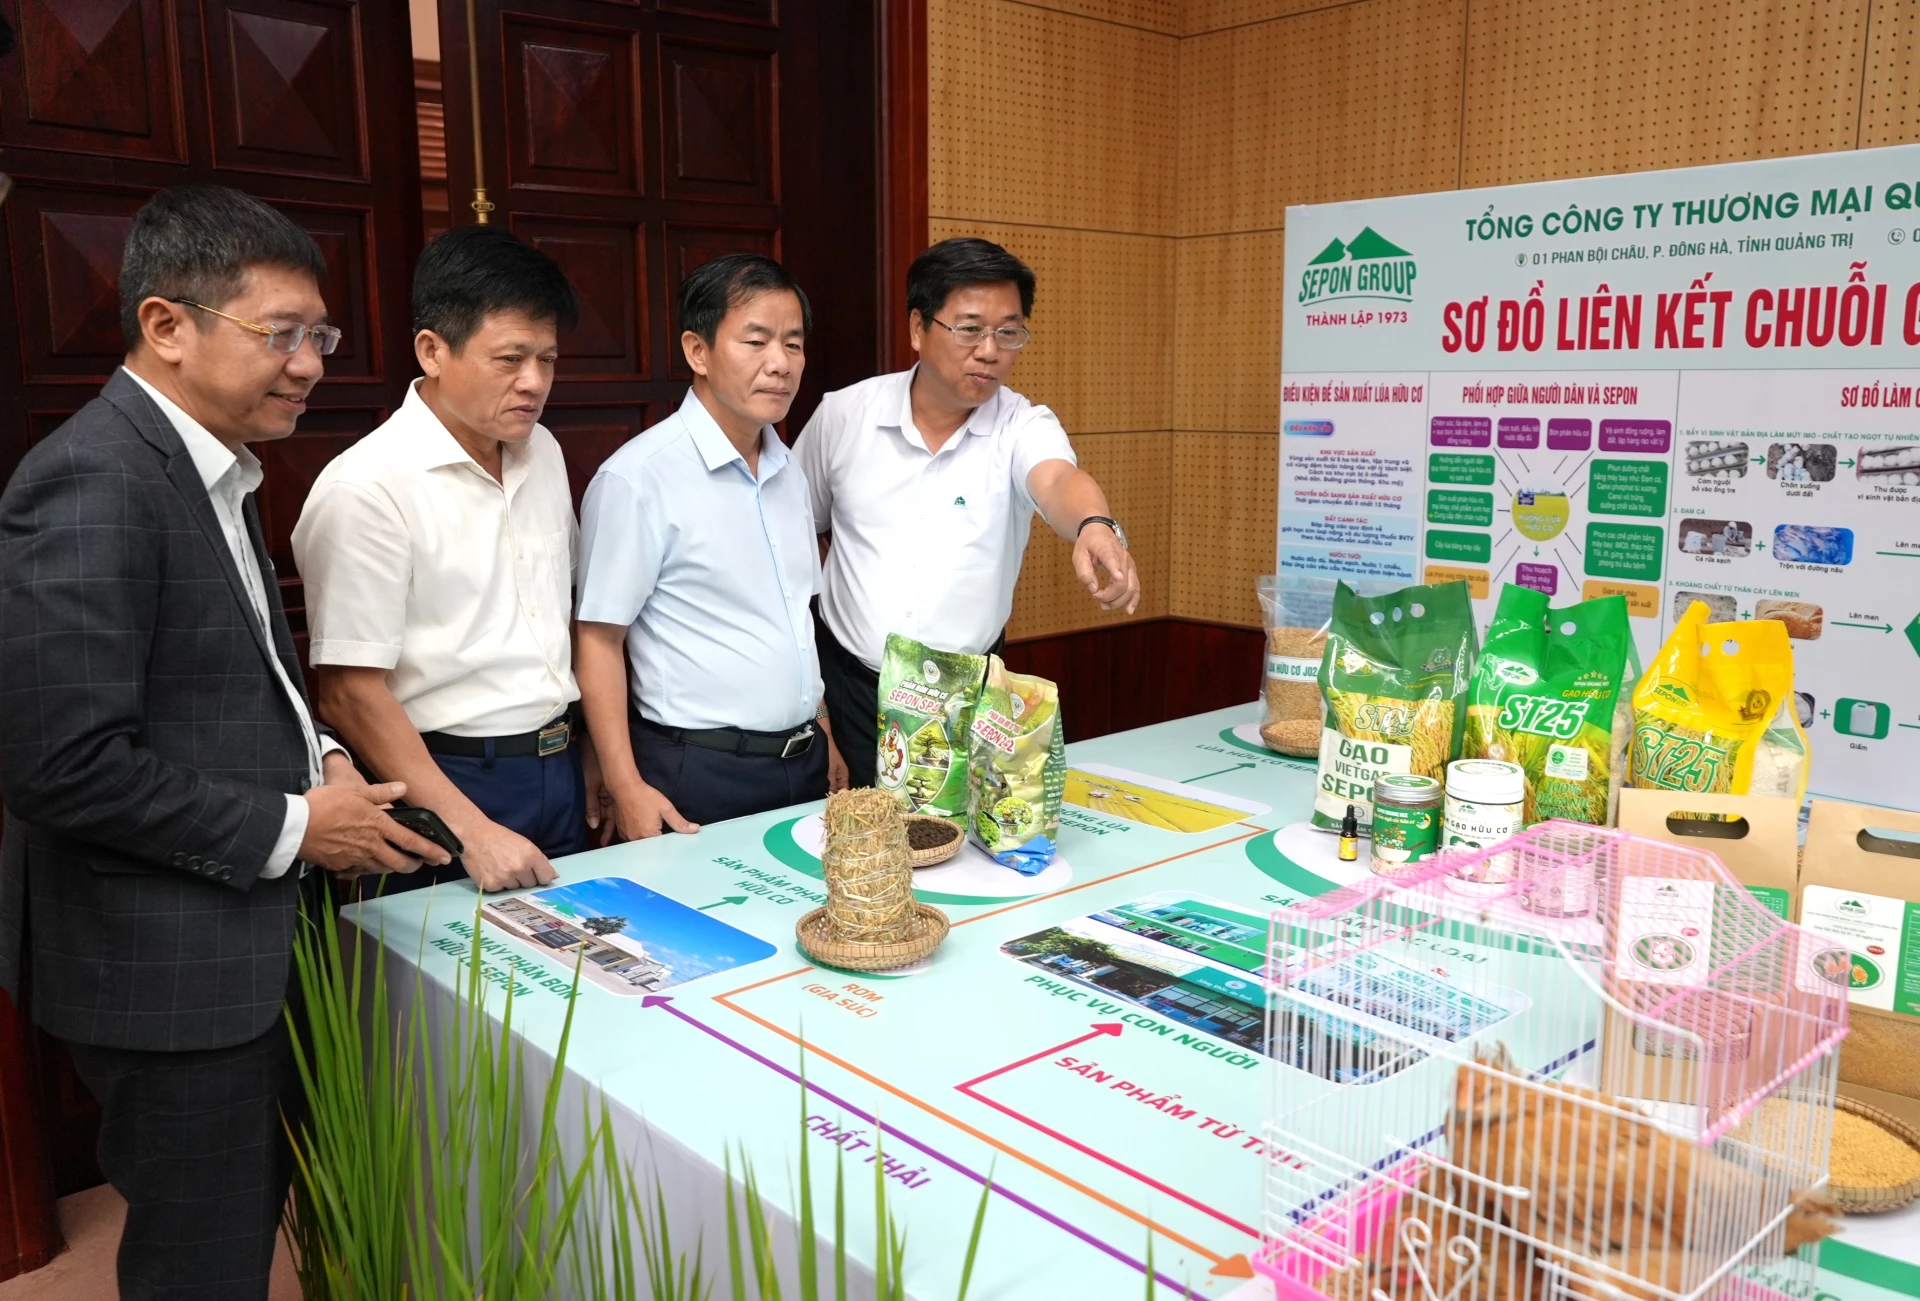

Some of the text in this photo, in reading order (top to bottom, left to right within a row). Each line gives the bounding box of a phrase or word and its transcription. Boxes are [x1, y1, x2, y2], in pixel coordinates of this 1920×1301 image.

[1466, 185, 1873, 241] TỔNG CÔNG TY THƯƠNG MẠI
[1551, 249, 1584, 264] PHAN
[1587, 246, 1609, 264] BỘI
[1611, 244, 1649, 261] CHÂU,
[1653, 244, 1666, 258] P.
[1669, 241, 1706, 257] ĐÔNG
[1710, 238, 1733, 255] HÀ,
[1737, 234, 1772, 253] TỈNH
[1775, 232, 1826, 251] QUẢNG
[1830, 232, 1854, 249] TRỊ
[1299, 261, 1417, 303] SEPON GROUP
[1306, 310, 1408, 327] THÀNH LẬP 1973
[1442, 261, 1888, 354] SƠ ĐỒ LIÊN KẾT CHUỖI
[1302, 383, 1320, 405] KIỆN
[1334, 381, 1350, 403] SẢN
[1352, 380, 1373, 403] XUẤT
[1375, 383, 1390, 403] LÚA
[1411, 384, 1424, 403] CƠ
[1462, 380, 1638, 408] PHỐI HỢP GIỮA NGƯỜI DÂN VÀ SEPON
[1841, 380, 1912, 408] SƠ ĐỒ LÀM
[1784, 590, 1800, 598] MEN
[1849, 612, 1880, 622] Lên men
[1290, 663, 1302, 677] CƠ
[890, 689, 920, 708] SEPON
[1354, 704, 1418, 737] ST25
[1498, 694, 1590, 740] ST25
[1339, 739, 1389, 766] GẠO
[1634, 725, 1727, 793] ST25
[1534, 791, 1594, 809] ORGANIC
[1546, 780, 1582, 796] 100%
[712, 856, 749, 872] SẢN
[743, 867, 794, 889] PHẨM
[733, 880, 800, 906] HỮU CƠ
[500, 954, 551, 981] PHÂN
[479, 966, 535, 998] SEPON
[841, 983, 885, 1003] RƠM
[802, 983, 879, 1019] (GIA SÚC)
[1023, 974, 1262, 1071] PHỤC VỤ CON NGƯỜI
[1054, 1057, 1247, 1139] SẢN PHẨM TỪ
[800, 1114, 934, 1190] CHẤT THẢI
